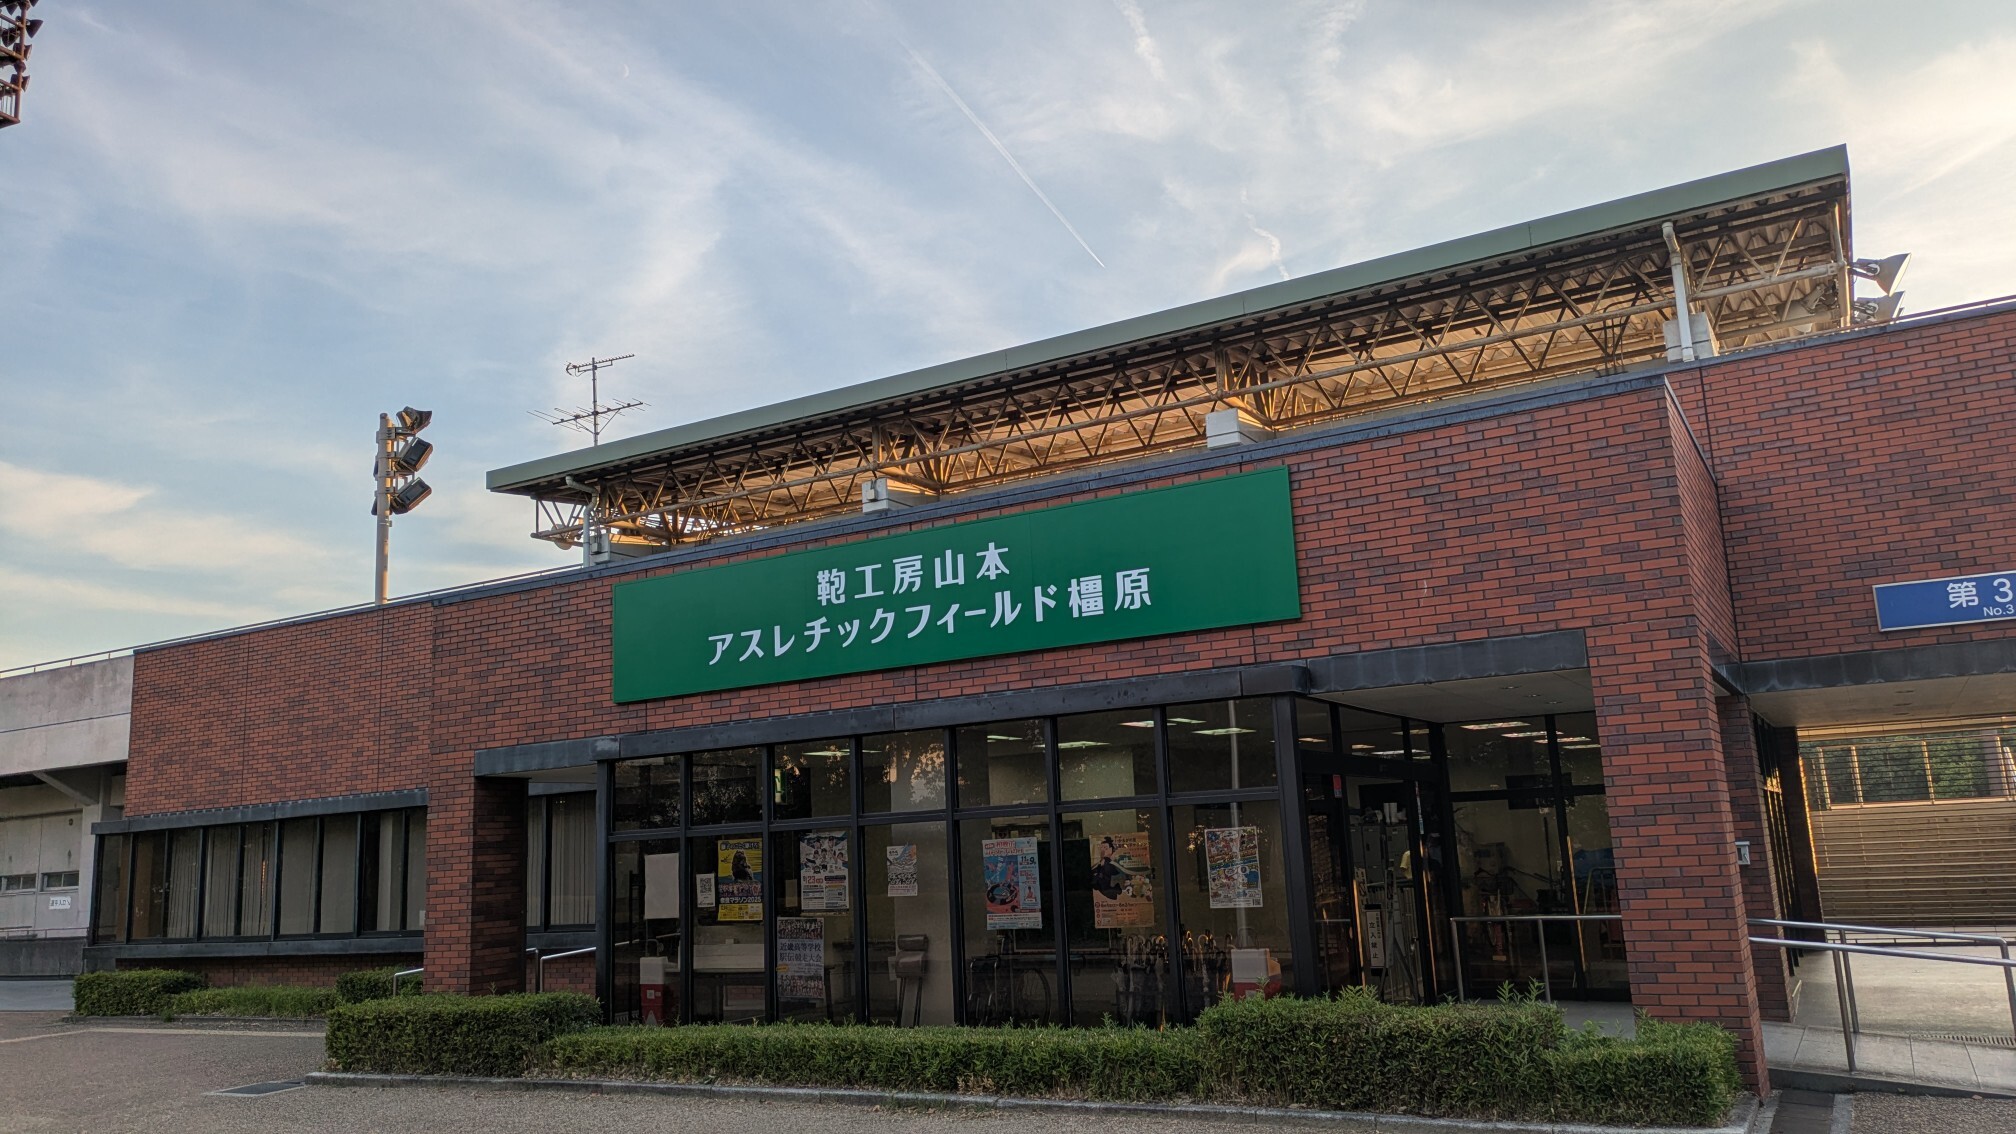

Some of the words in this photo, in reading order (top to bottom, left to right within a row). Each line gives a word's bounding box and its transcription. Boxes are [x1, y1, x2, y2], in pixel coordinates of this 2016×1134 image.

[816, 541, 1011, 607] 鞄工房山本
[706, 567, 1153, 666] アスレチックフィールド橿原
[779, 942, 822, 952] 近畿高等学校
[779, 952, 822, 962] 駅伝競走大会
